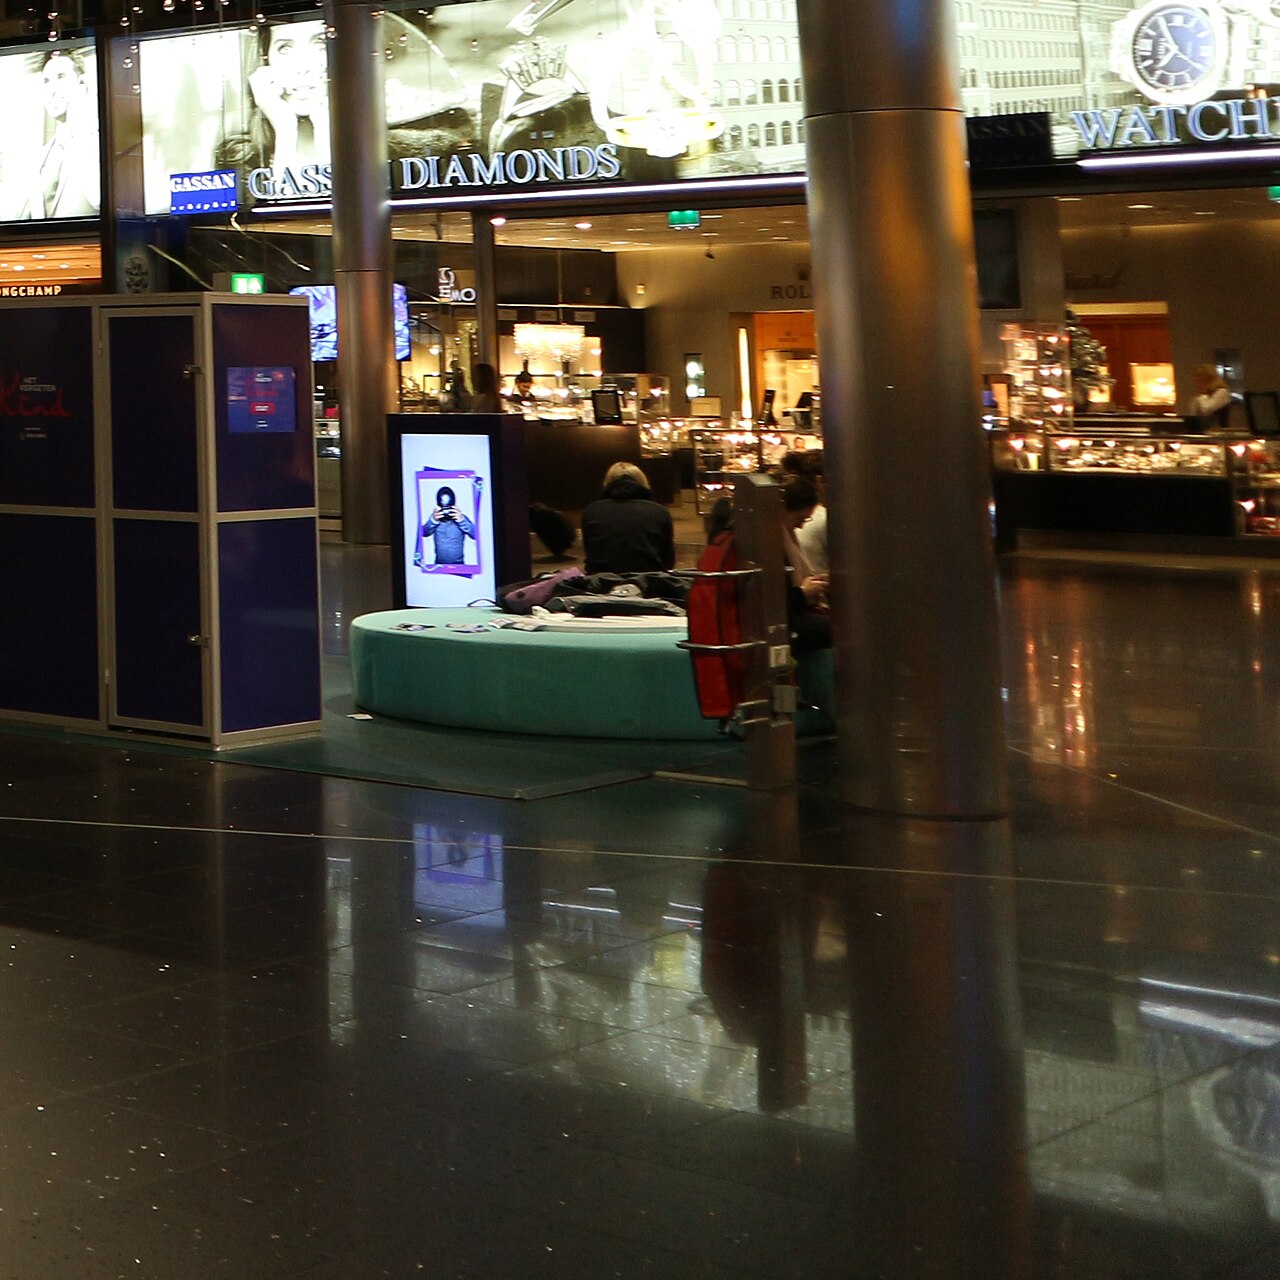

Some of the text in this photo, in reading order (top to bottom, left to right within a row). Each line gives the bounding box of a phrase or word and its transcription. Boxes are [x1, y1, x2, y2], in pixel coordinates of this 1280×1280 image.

[1070, 95, 1280, 148] WATCH
[170, 173, 236, 193] GASSAN
[400, 143, 622, 190] DIAMONDS
[770, 284, 813, 300] ROL
